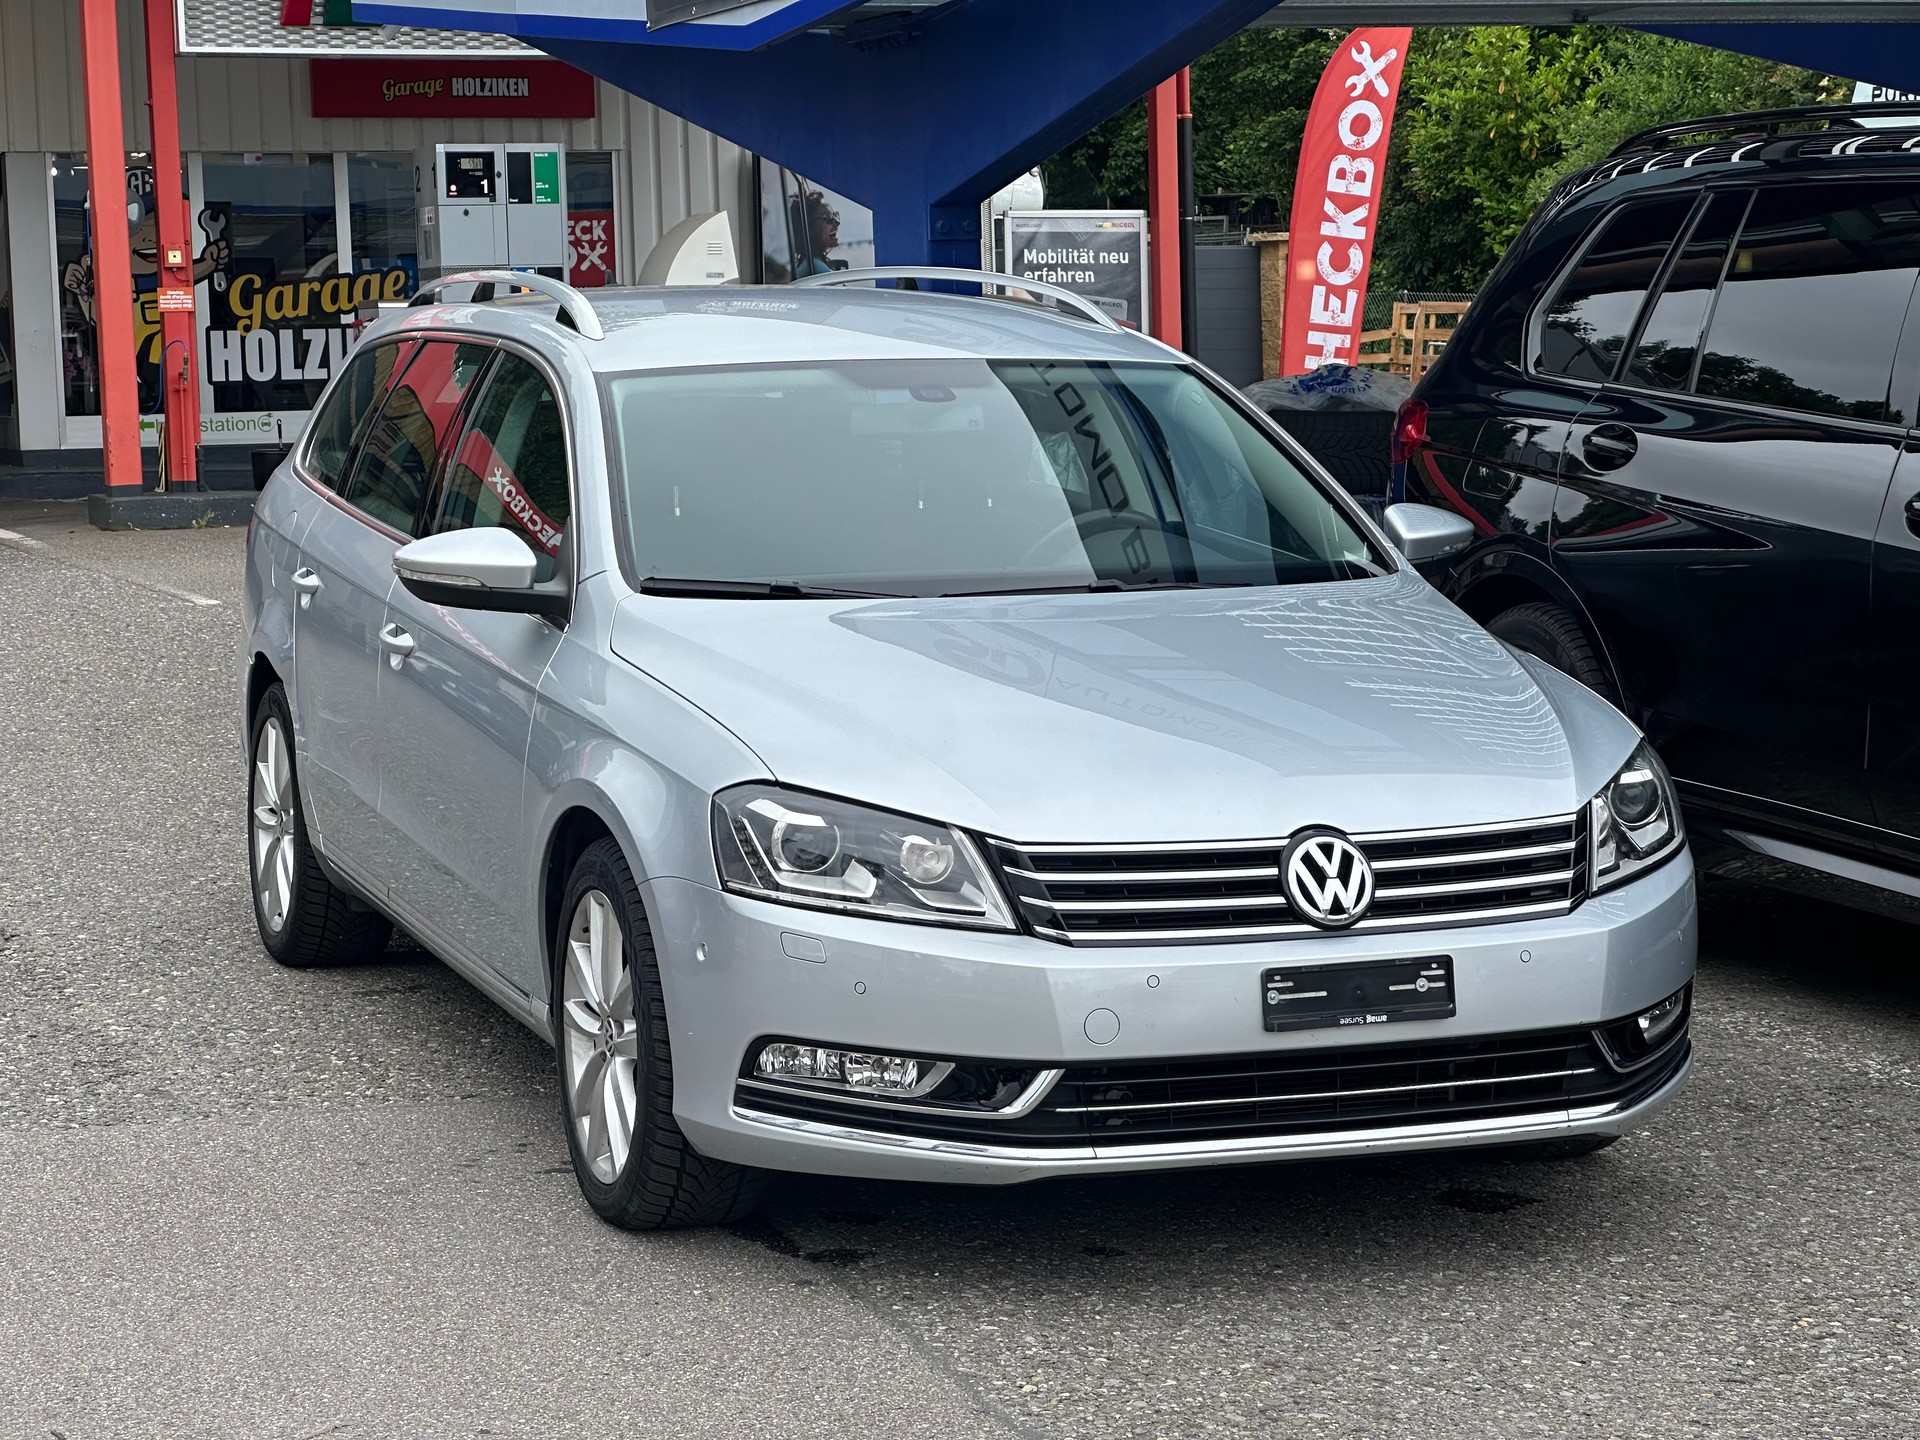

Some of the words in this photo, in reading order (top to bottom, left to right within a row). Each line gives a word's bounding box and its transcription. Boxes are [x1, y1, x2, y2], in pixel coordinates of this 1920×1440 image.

[382, 78, 444, 101] Garage
[452, 77, 529, 97] HOLZIKEN
[480, 179, 489, 194] 1
[1023, 248, 1095, 264] Mobilität
[1099, 252, 1129, 264] neu
[1023, 267, 1095, 283] erfahren
[228, 270, 407, 337] Garage
[1339, 1015, 1365, 1025] Sursee
[1365, 1013, 1388, 1024] amag
